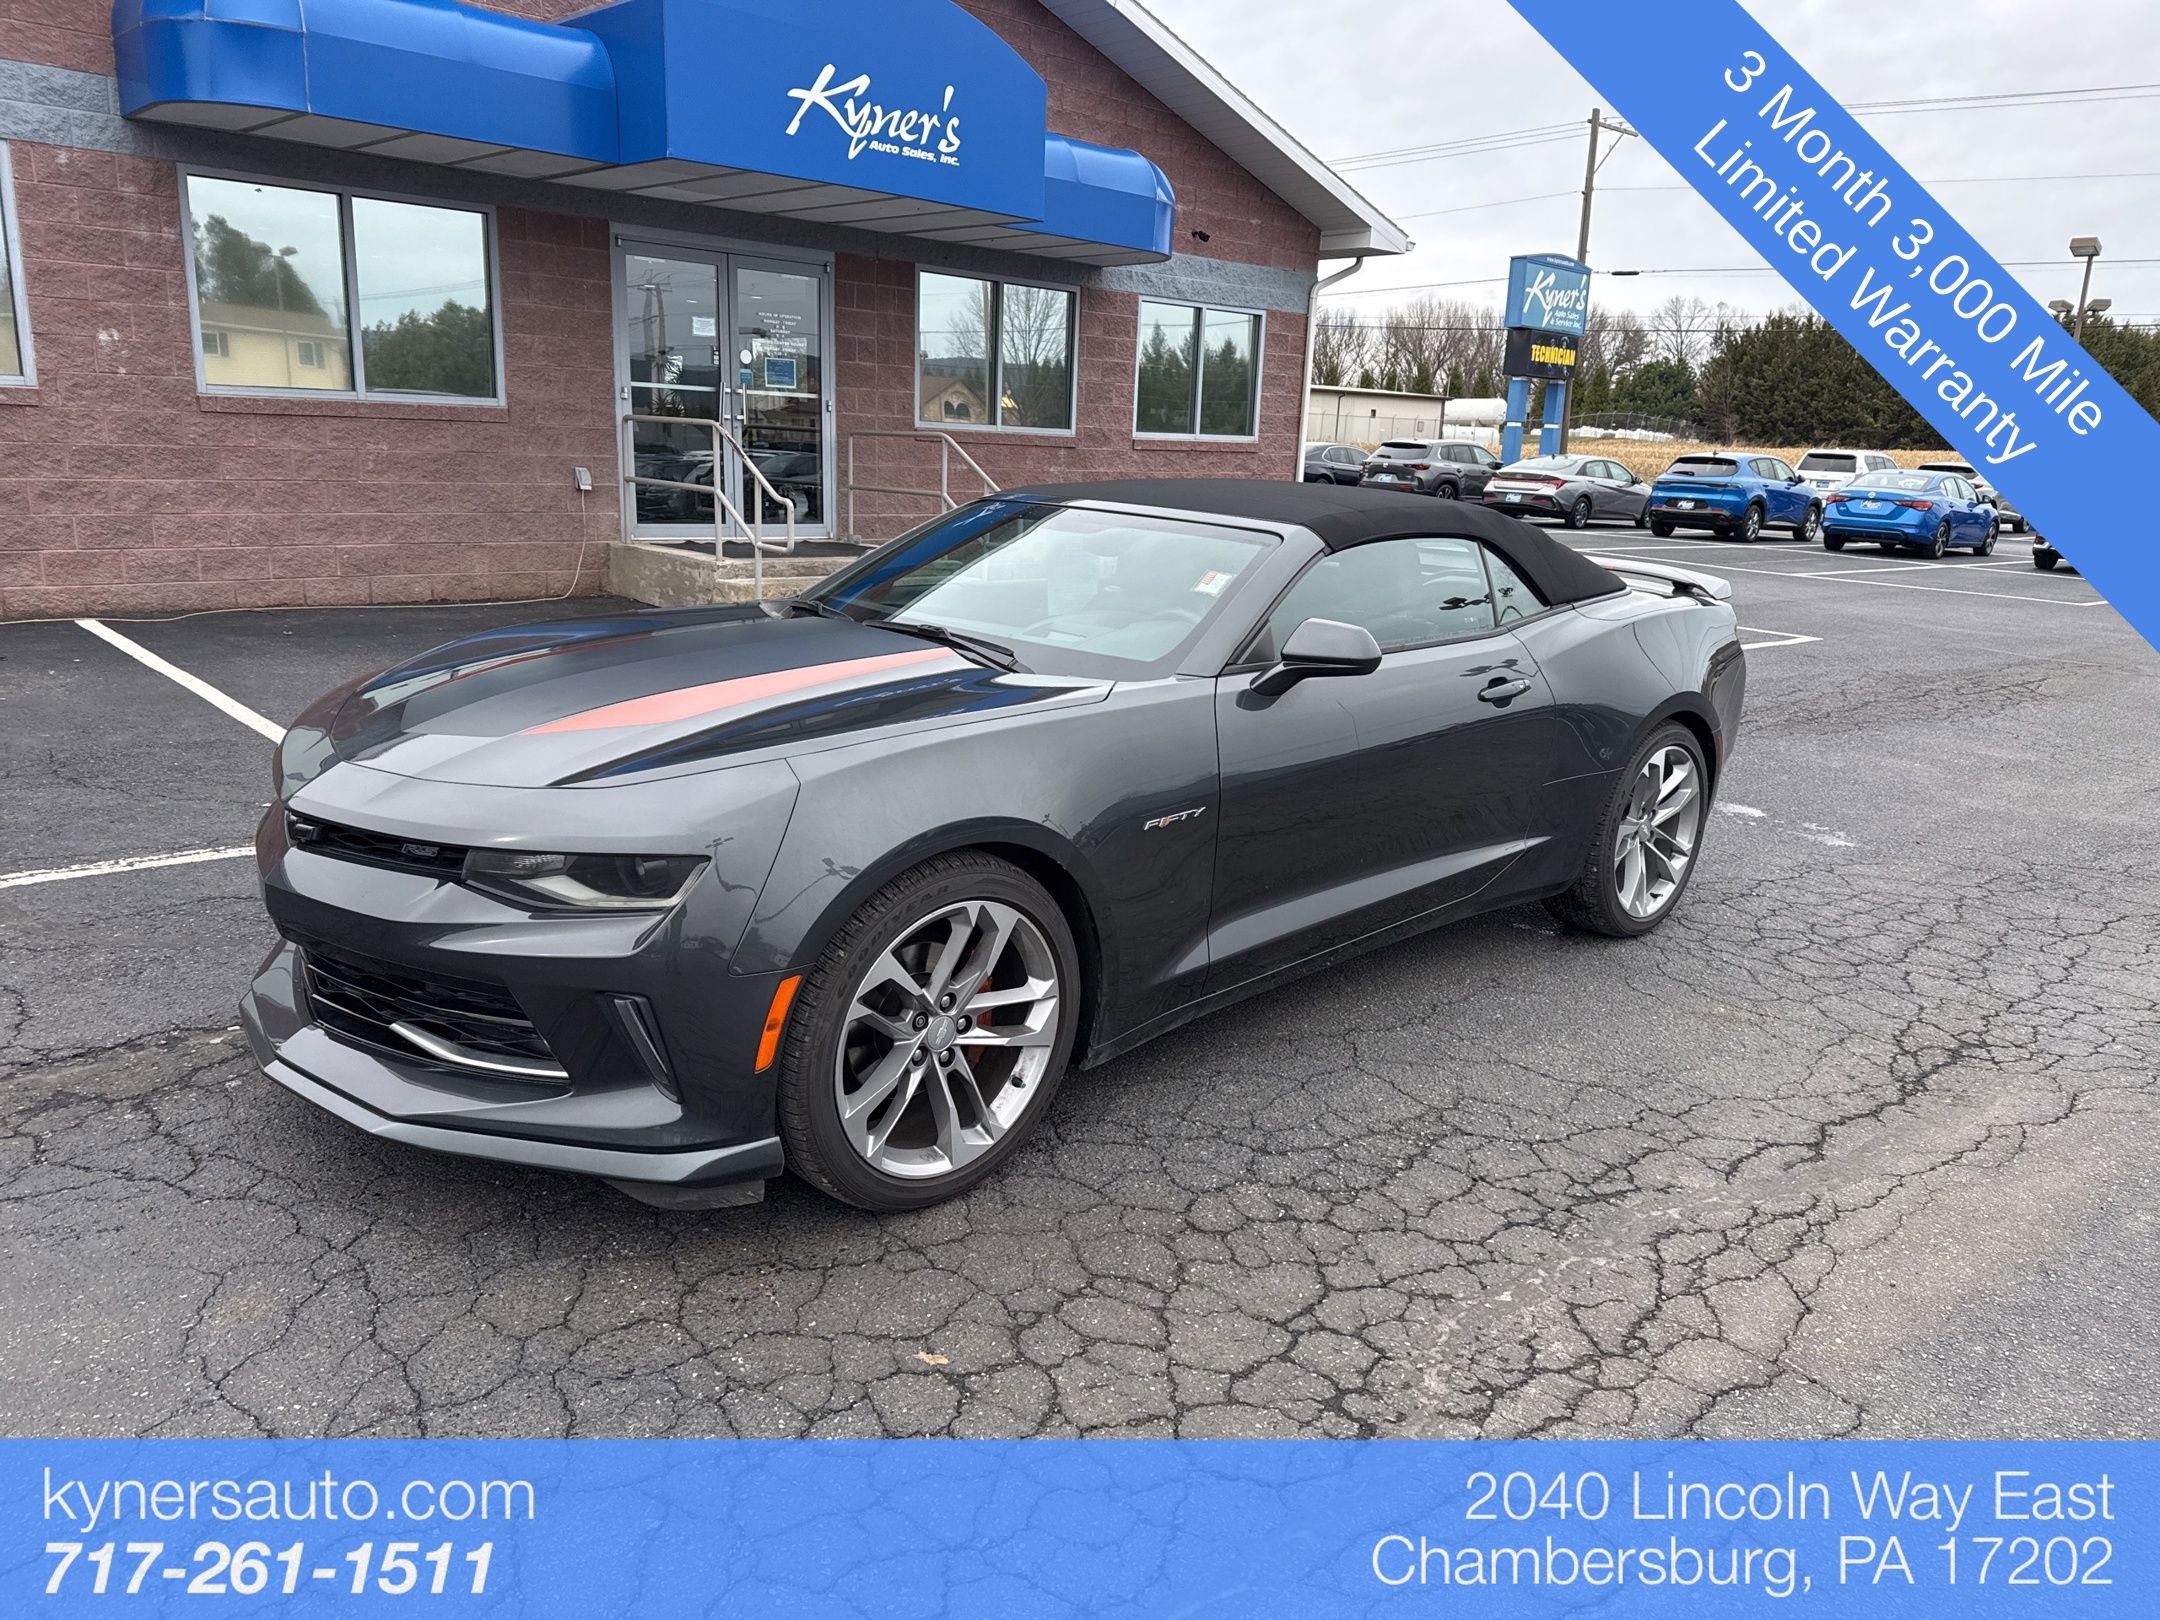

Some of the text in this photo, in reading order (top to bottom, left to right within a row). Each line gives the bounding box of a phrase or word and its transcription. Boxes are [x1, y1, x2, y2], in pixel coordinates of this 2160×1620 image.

[785, 63, 961, 160] Kyner's
[868, 140, 960, 167] Auto Sales, Inc.
[1523, 269, 1587, 328] Kyner's
[1531, 344, 1576, 367] TECHNICIAN
